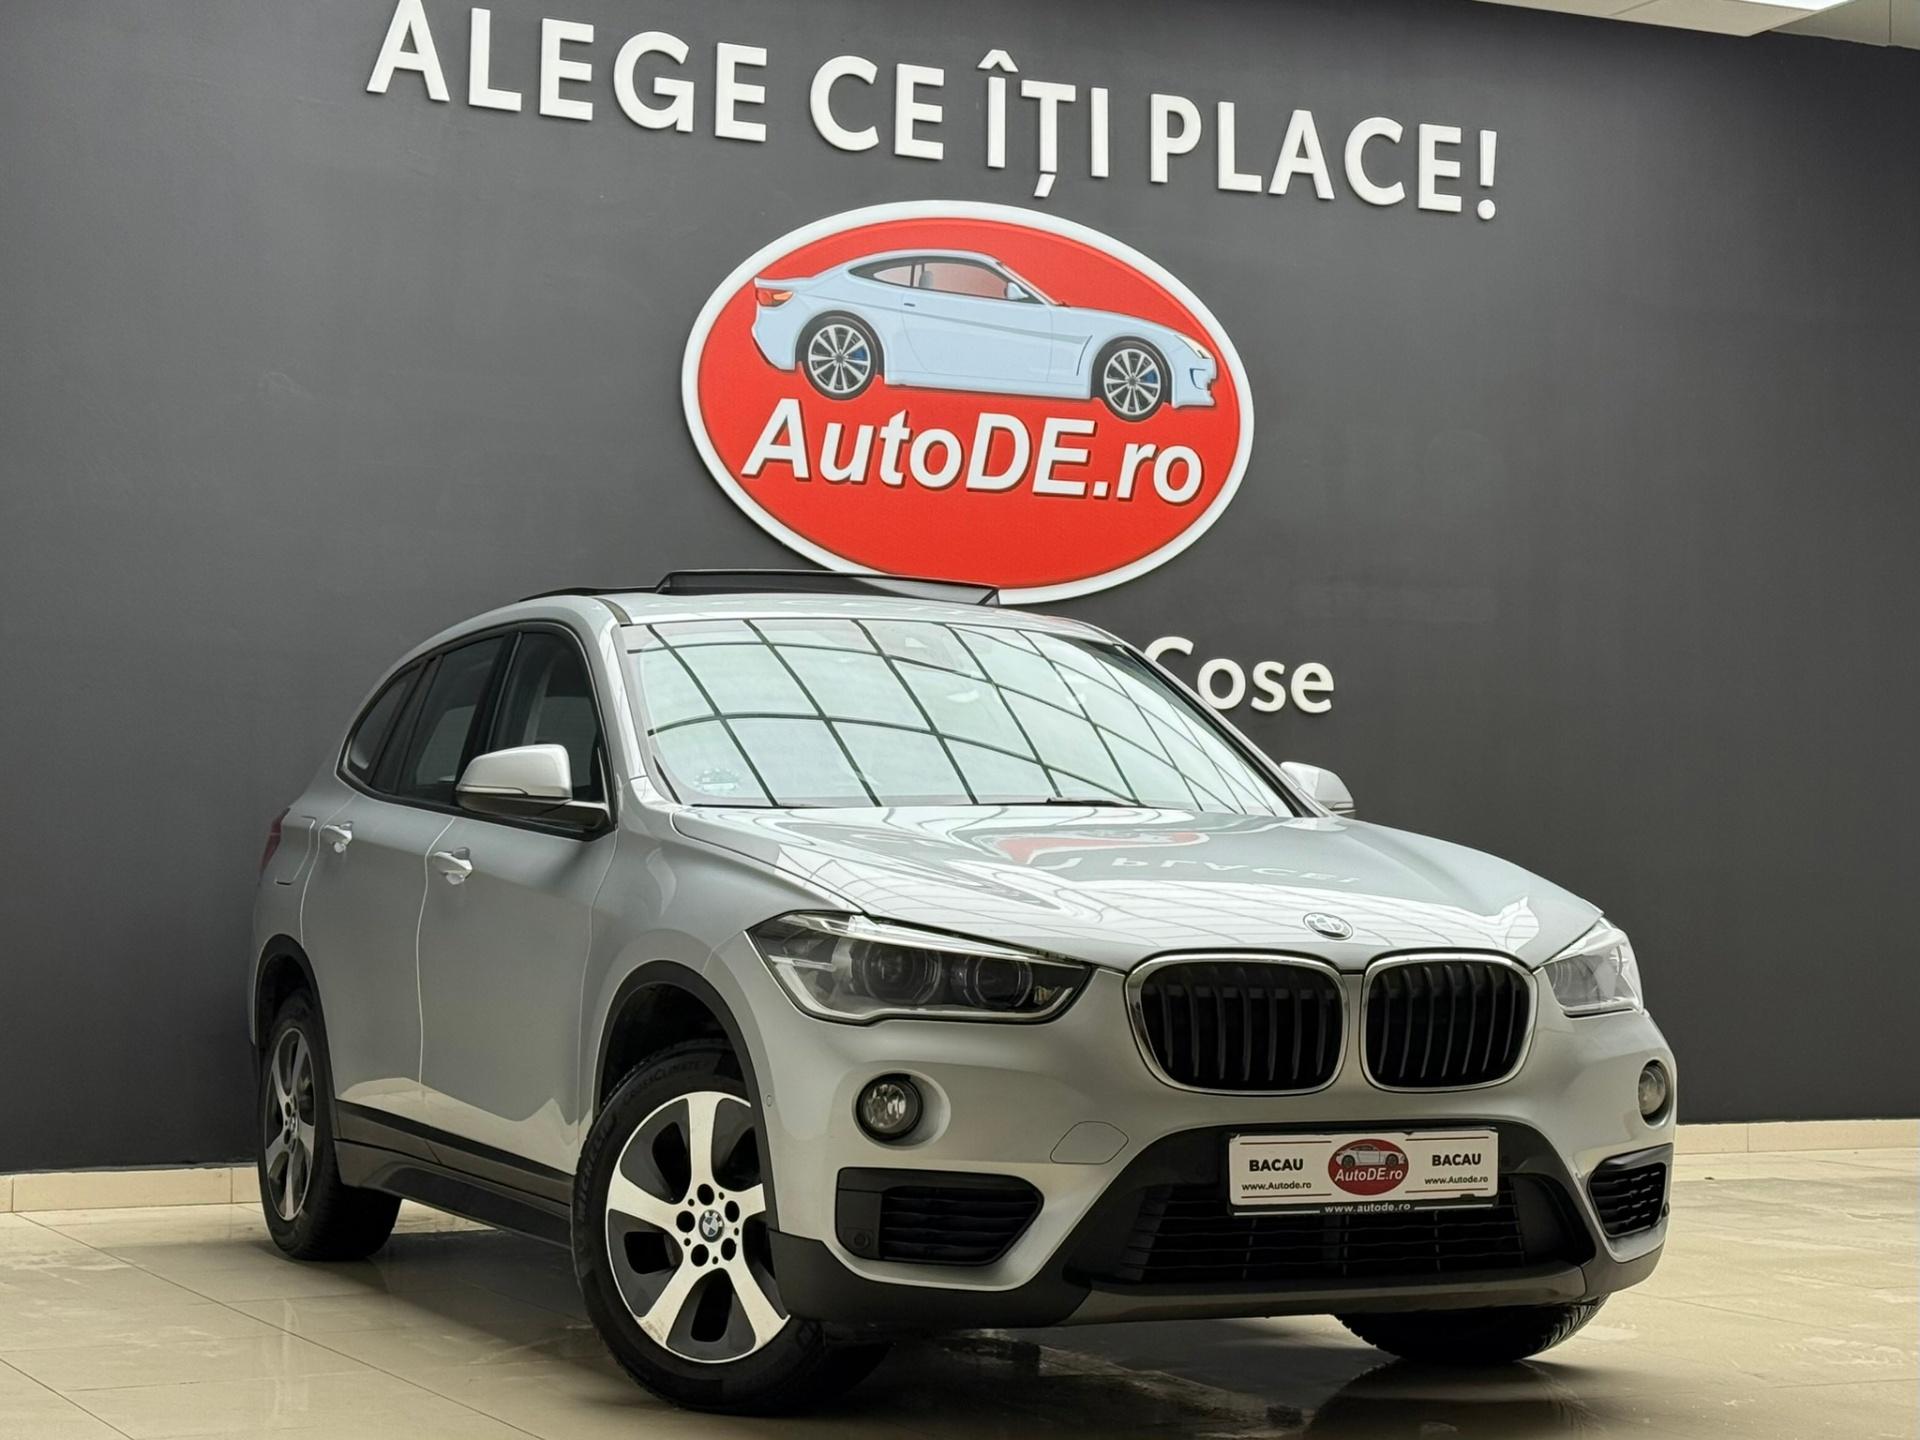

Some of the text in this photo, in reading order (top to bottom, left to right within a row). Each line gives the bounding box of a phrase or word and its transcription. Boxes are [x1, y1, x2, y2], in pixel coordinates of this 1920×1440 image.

[366, 0, 1498, 220] ALEGE CE ÎȚI PLACE!
[741, 398, 1203, 503] AutoDE.ro
[1249, 1158, 1304, 1172] BACAU
[1431, 1153, 1482, 1167] BACAU
[1335, 1167, 1403, 1182] AutoDE.ro
[1424, 1175, 1489, 1185] www.Autode.ro
[1241, 1181, 1312, 1191] www.Autode.ro
[1324, 1202, 1411, 1214] www.autode.ro
